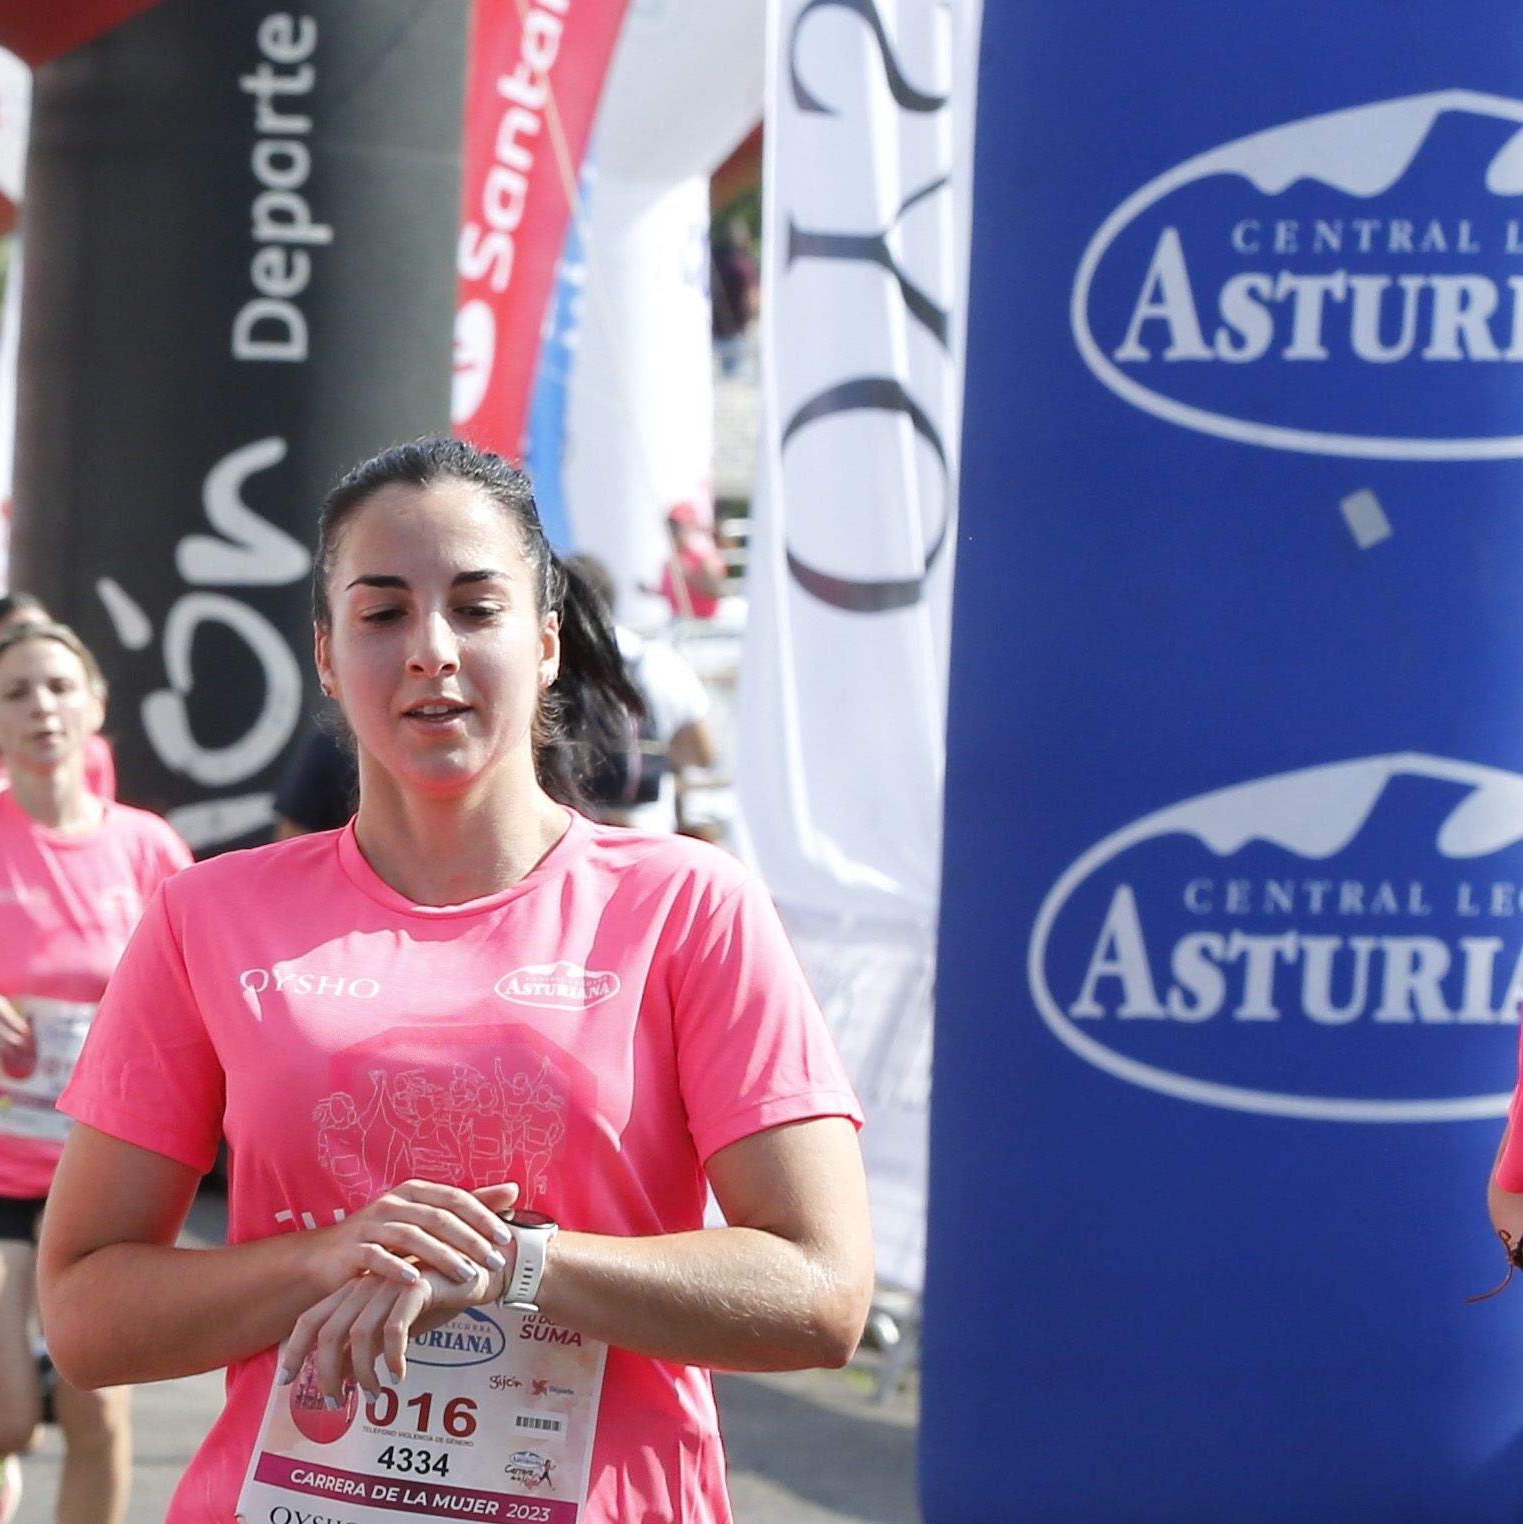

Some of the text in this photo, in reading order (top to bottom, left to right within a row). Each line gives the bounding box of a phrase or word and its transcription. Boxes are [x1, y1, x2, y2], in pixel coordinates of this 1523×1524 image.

[455, 0, 571, 294] Santa
[233, 9, 333, 364] Deporte
[1231, 218, 1481, 253] CENTRAL
[1183, 879, 1523, 917] CENTRAL LE
[239, 967, 381, 999] OYSHO
[409, 1330, 494, 1355] URIANA
[519, 1323, 582, 1347] SUMA
[364, 1385, 478, 1438] 016
[376, 1445, 450, 1477] 4334
[290, 1468, 552, 1523] CARRERA DE LA MUJER 2023
